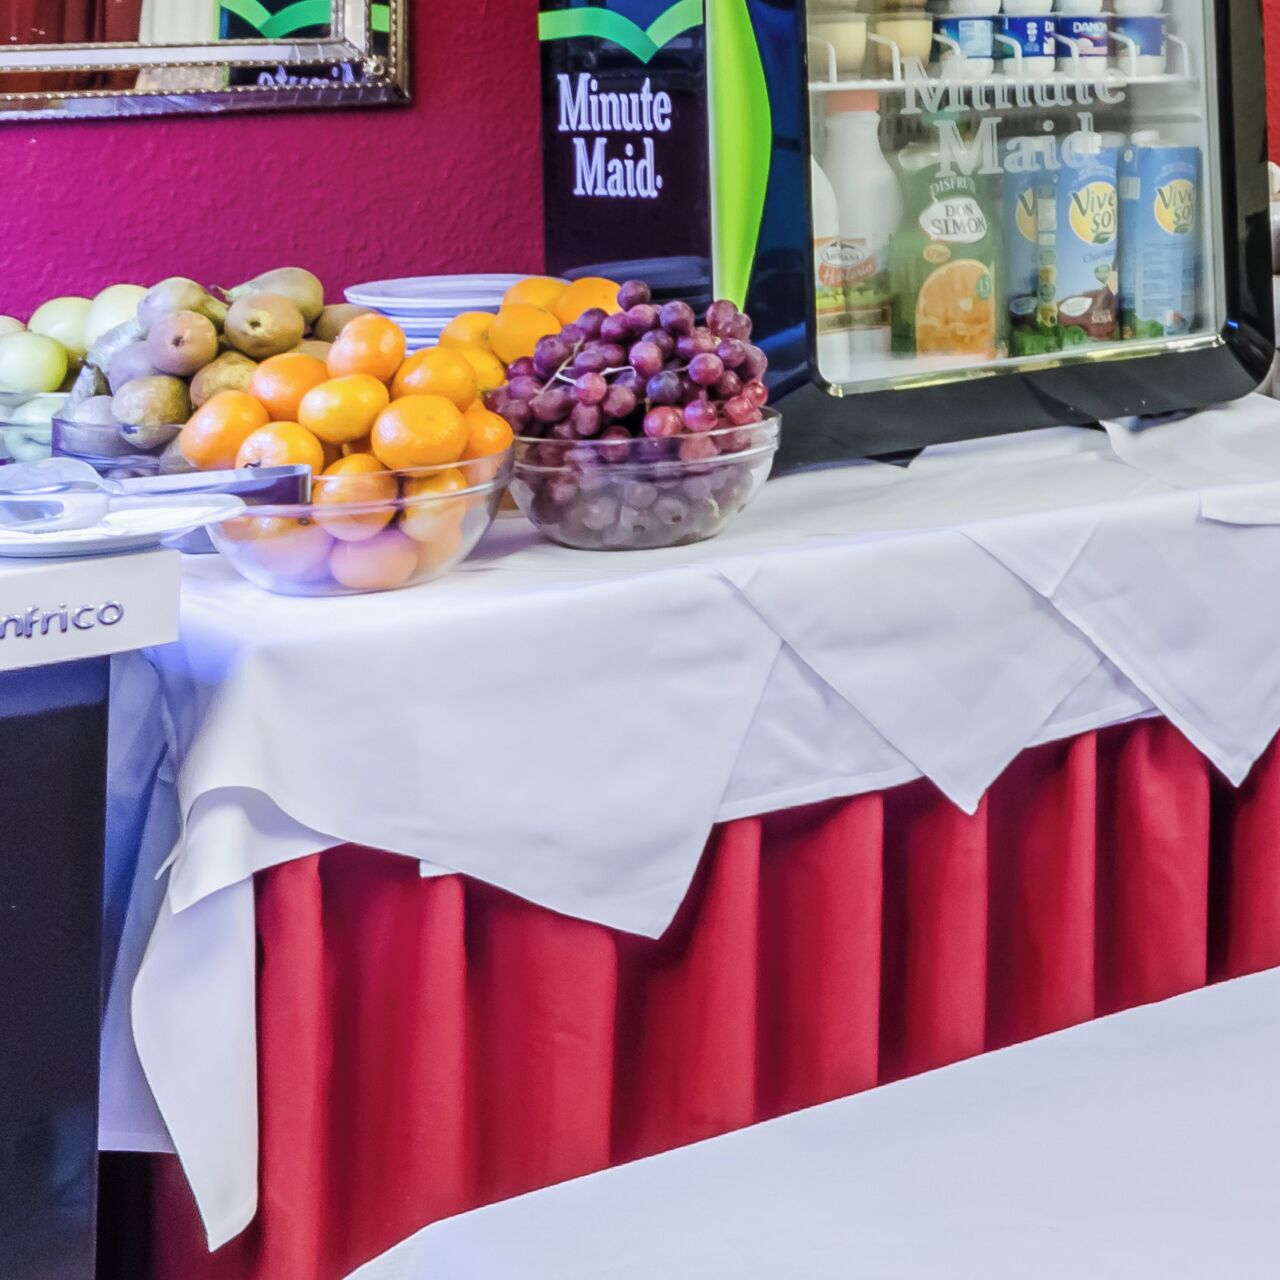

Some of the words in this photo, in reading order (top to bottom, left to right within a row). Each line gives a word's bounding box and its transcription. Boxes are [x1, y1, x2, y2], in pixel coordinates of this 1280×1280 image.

[556, 72, 673, 132] Minute
[932, 111, 1100, 179] Maid
[930, 215, 987, 236] SIMON
[944, 203, 975, 218] DON
